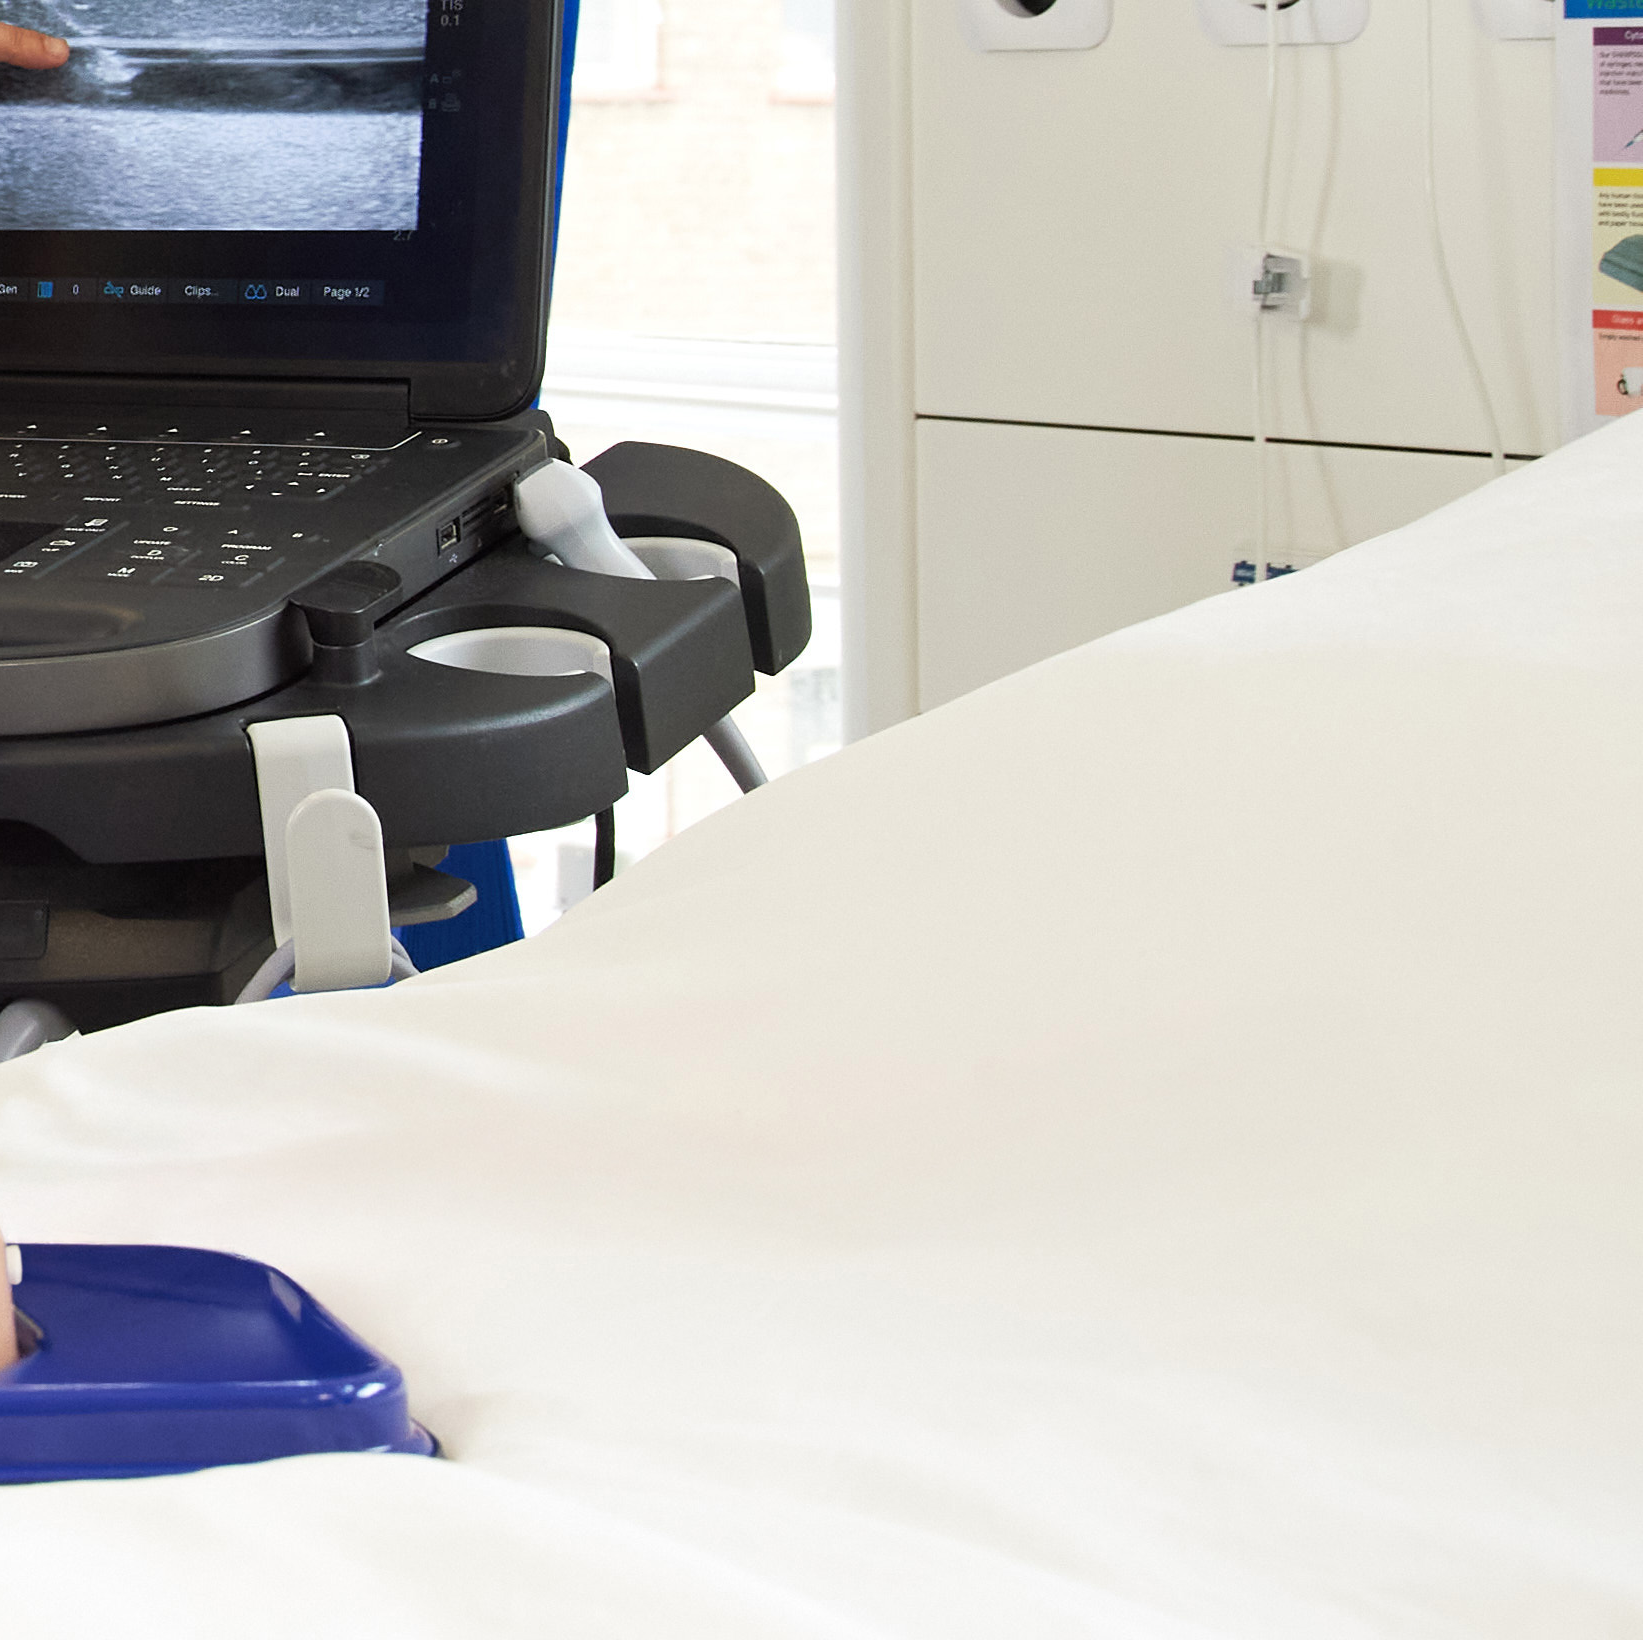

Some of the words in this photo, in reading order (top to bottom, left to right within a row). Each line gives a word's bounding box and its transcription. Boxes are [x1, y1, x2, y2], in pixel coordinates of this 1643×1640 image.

[129, 284, 162, 296] Guide
[275, 286, 300, 298] Dual
[323, 286, 352, 300] Page
